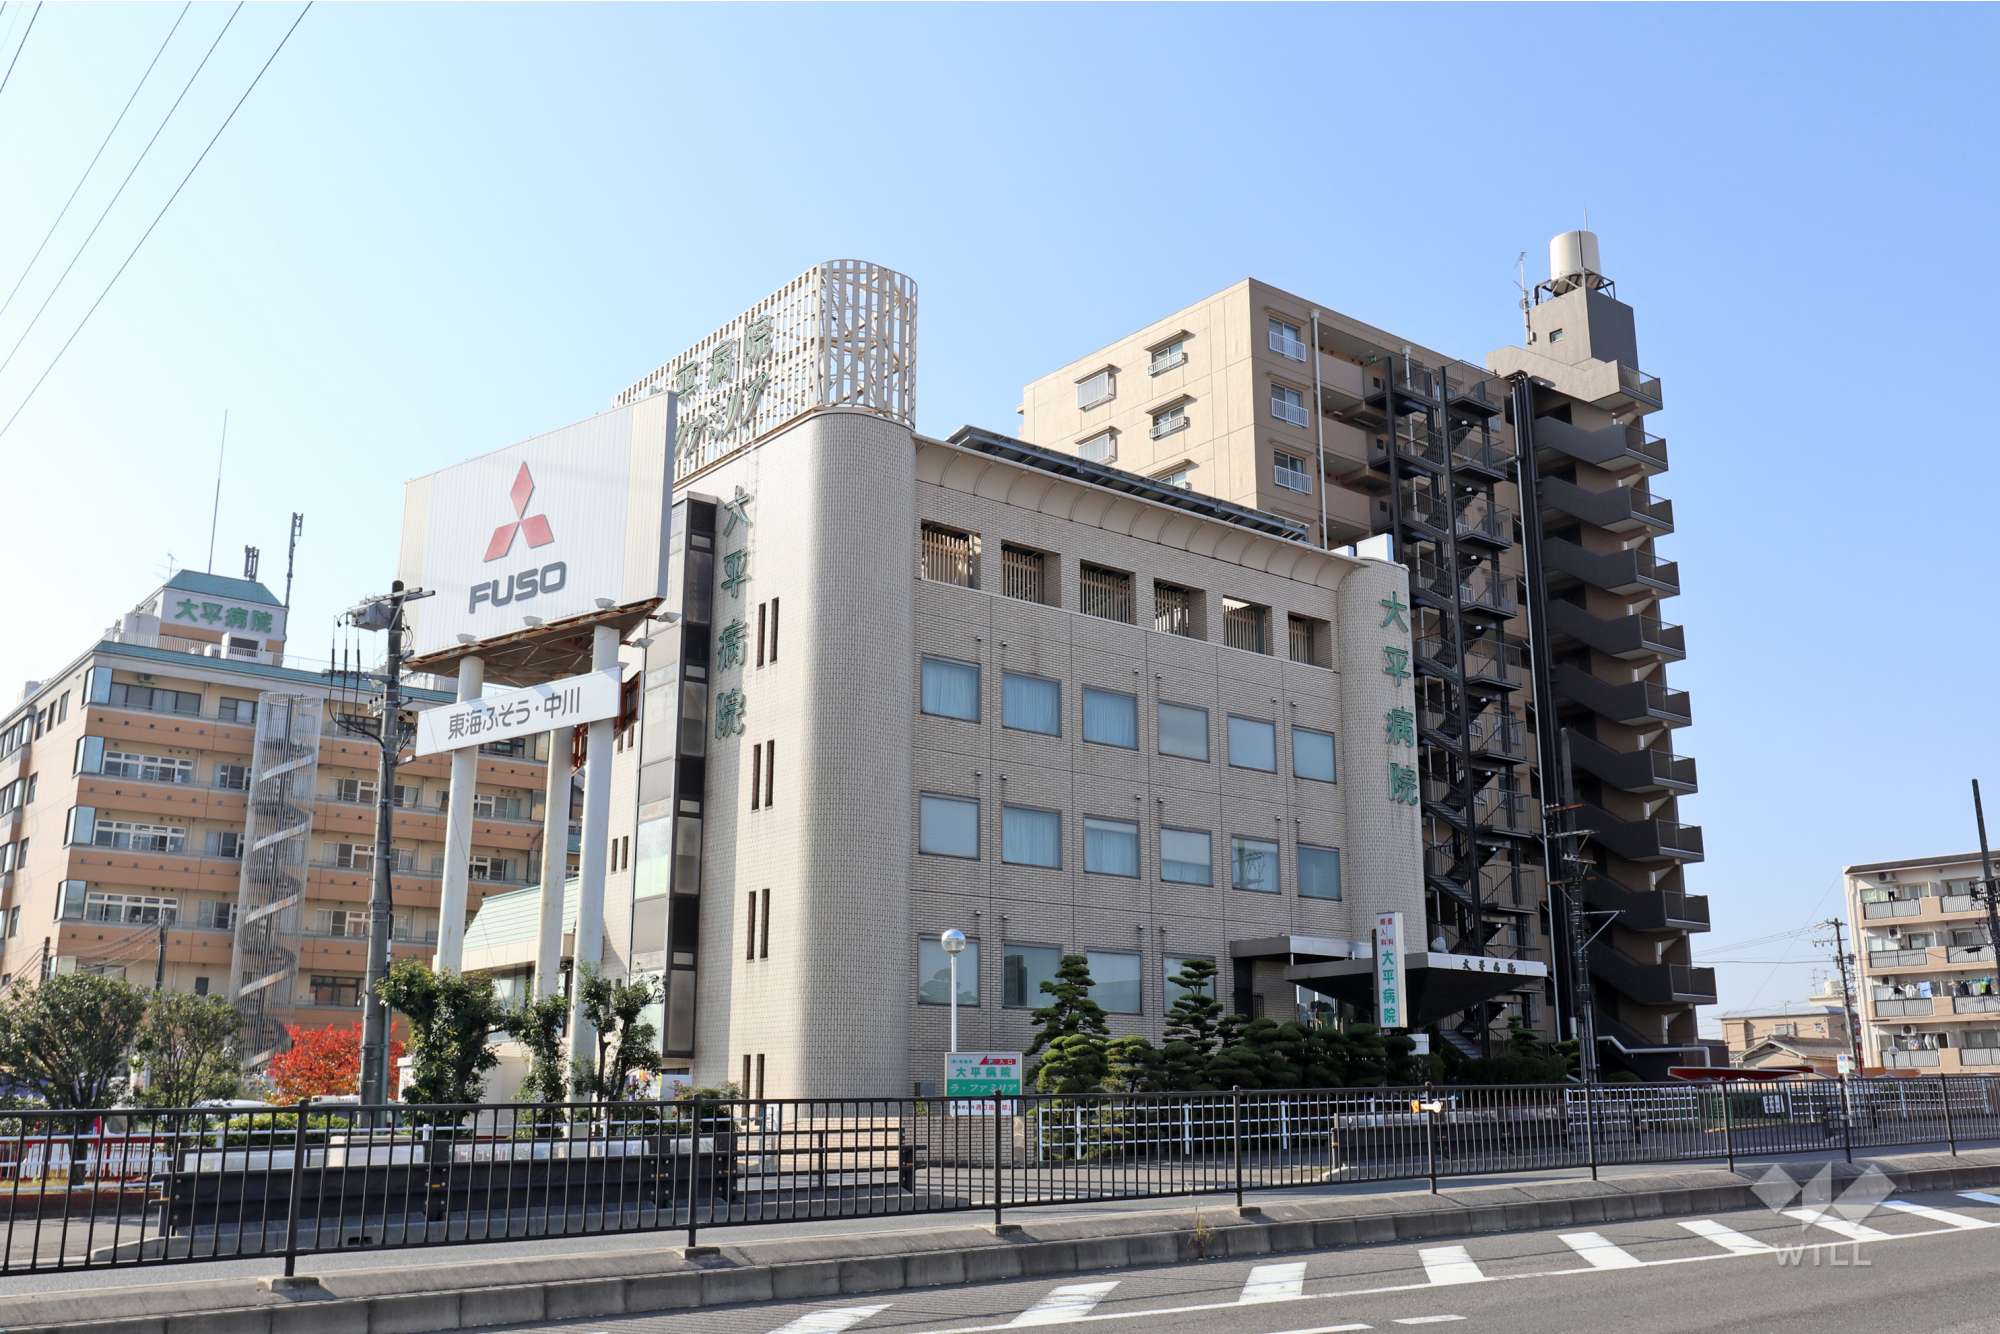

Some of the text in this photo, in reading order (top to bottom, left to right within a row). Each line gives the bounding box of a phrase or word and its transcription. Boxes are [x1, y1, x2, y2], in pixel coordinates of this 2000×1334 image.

[649, 314, 773, 400] 平病院
[174, 598, 273, 634] 大平病院
[468, 561, 567, 614] FUSO
[715, 485, 753, 740] 大平病院
[448, 687, 581, 740] 東海ふそう・中川
[1379, 591, 1418, 806] 大平病院
[1382, 950, 1396, 1024] 大平病院
[955, 1066, 1011, 1078] 大平病院
